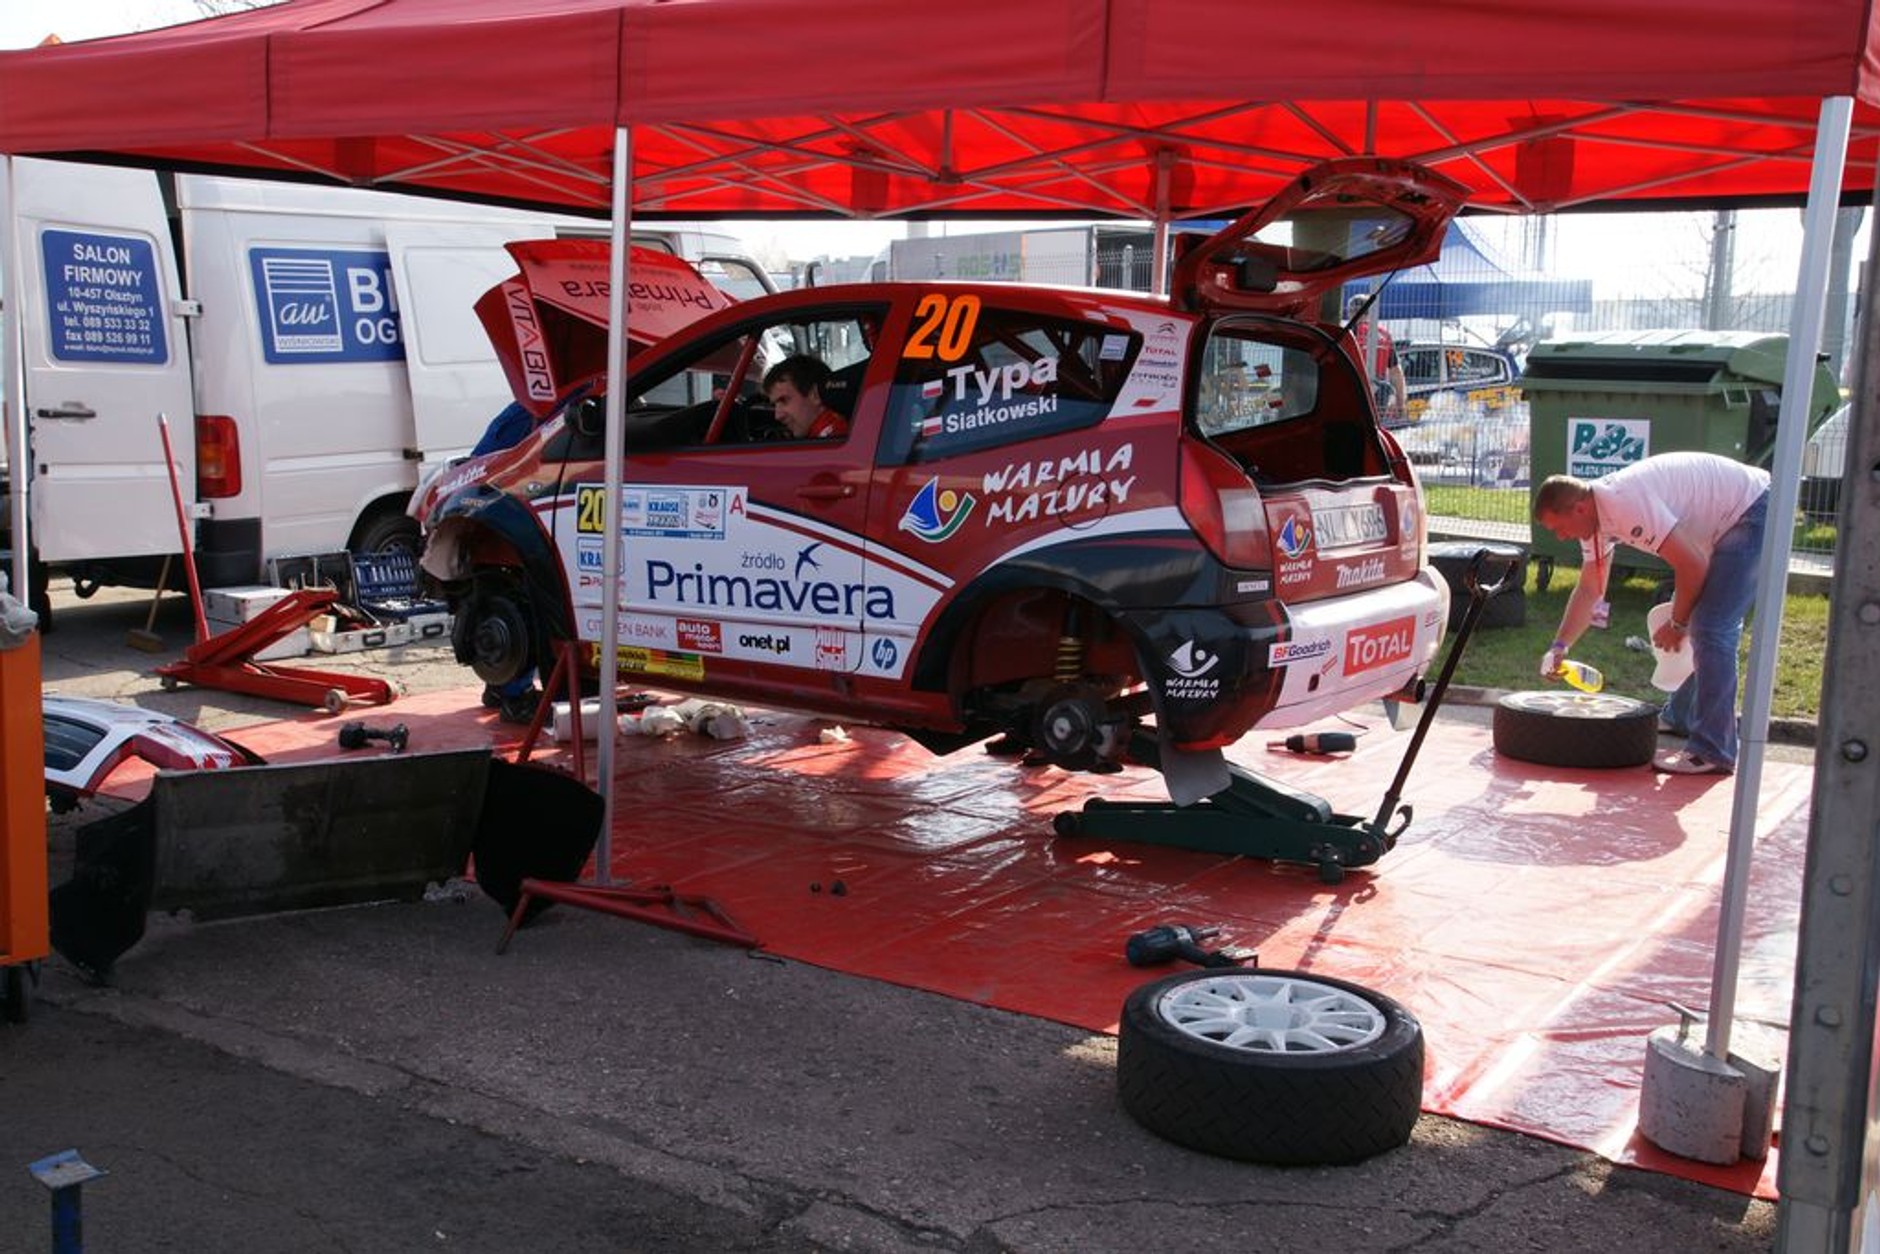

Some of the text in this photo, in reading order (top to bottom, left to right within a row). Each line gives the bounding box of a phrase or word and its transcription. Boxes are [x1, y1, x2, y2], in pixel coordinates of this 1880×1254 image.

[73, 243, 131, 265] SALON
[64, 264, 142, 287] FIRMOWY
[68, 286, 102, 300] 10-457
[559, 278, 705, 311] Primaera
[355, 318, 404, 345] OG
[901, 293, 982, 362] 20
[947, 354, 1058, 406] Typa
[946, 394, 1058, 434] Siatkowski
[983, 443, 1133, 495] WARMIA
[578, 488, 606, 532] 20
[729, 494, 745, 516] A
[985, 475, 1137, 528] MAZURY
[741, 551, 786, 571] źródło
[646, 560, 897, 619] Primavera
[739, 634, 790, 655] onet.pl
[876, 639, 895, 669] hp
[1273, 638, 1332, 660] BFGoodrich
[1350, 627, 1412, 667] TOTAL
